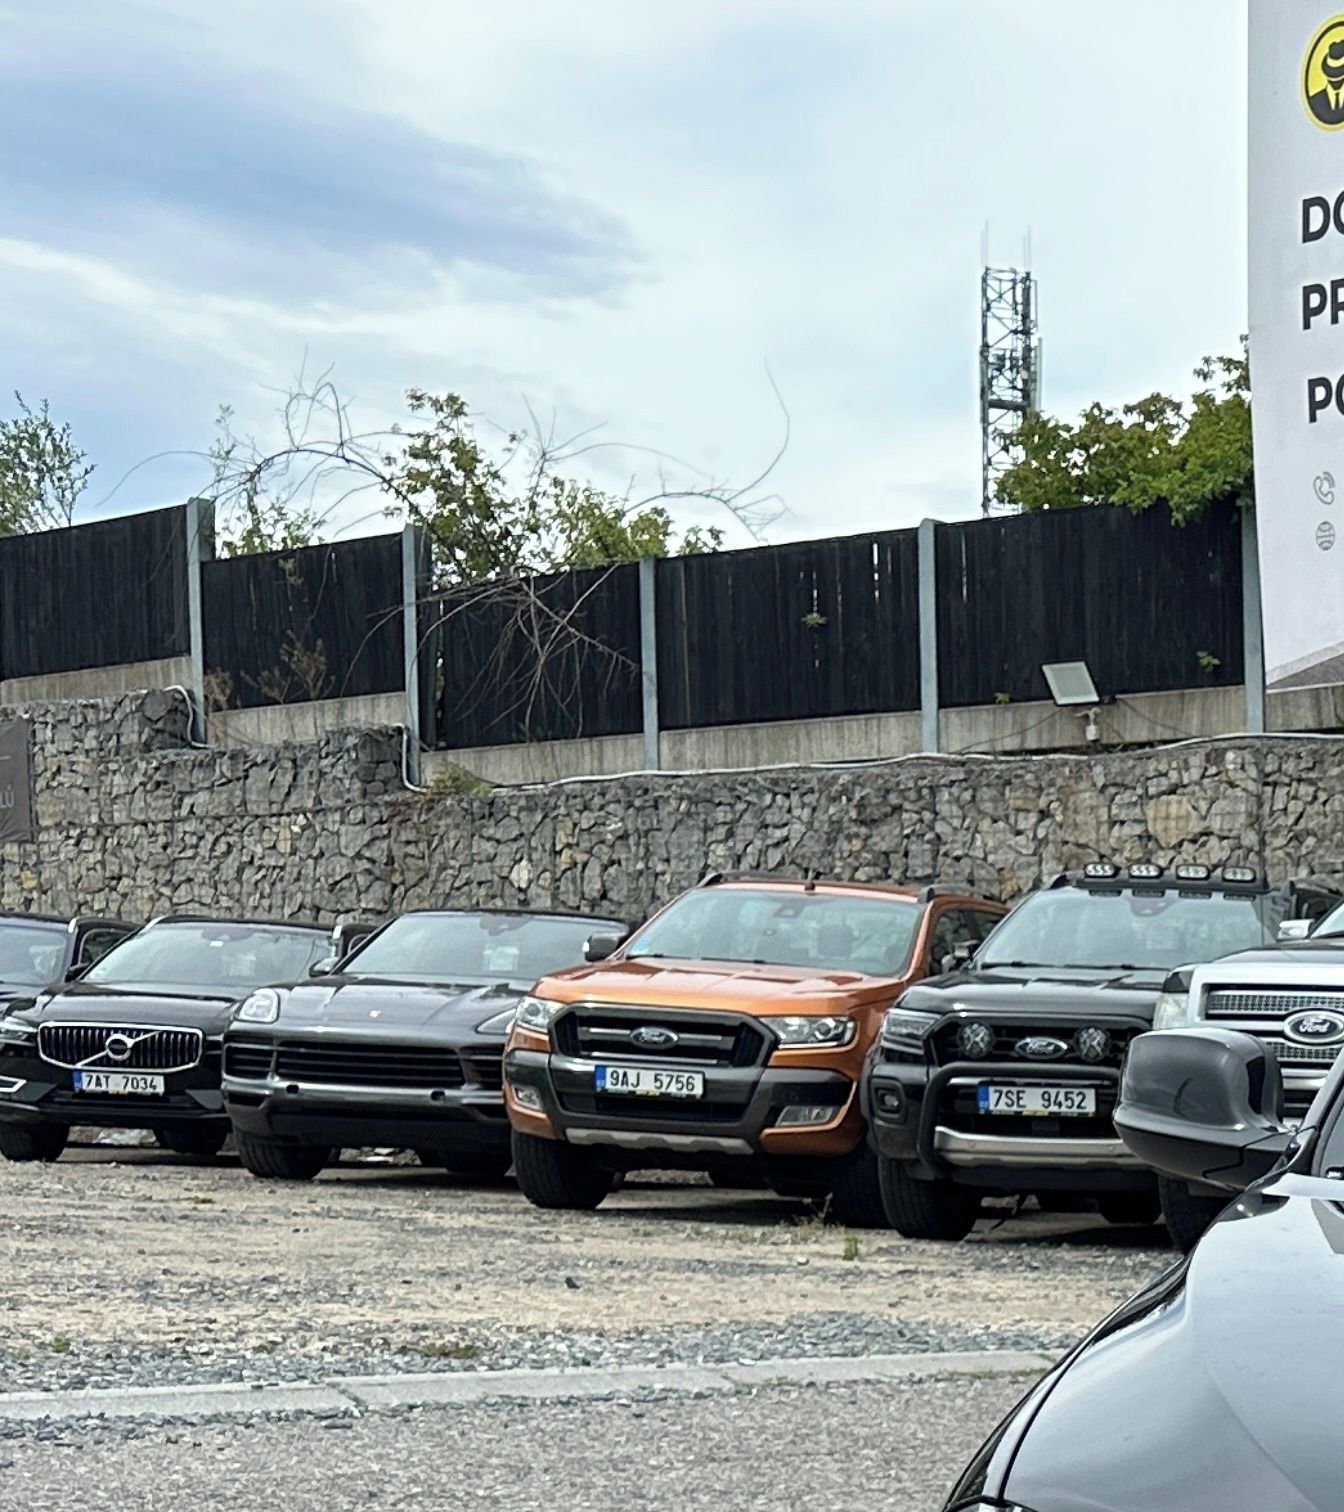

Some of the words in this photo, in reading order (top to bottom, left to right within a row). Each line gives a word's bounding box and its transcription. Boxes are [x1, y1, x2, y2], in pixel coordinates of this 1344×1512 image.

[85, 1074, 111, 1089] 7AT
[122, 1075, 157, 1091] 7034
[610, 1070, 641, 1089] 9AJ
[653, 1072, 695, 1093] 5756
[993, 1089, 1026, 1109] 7SE
[1041, 1091, 1087, 1110] 9452
